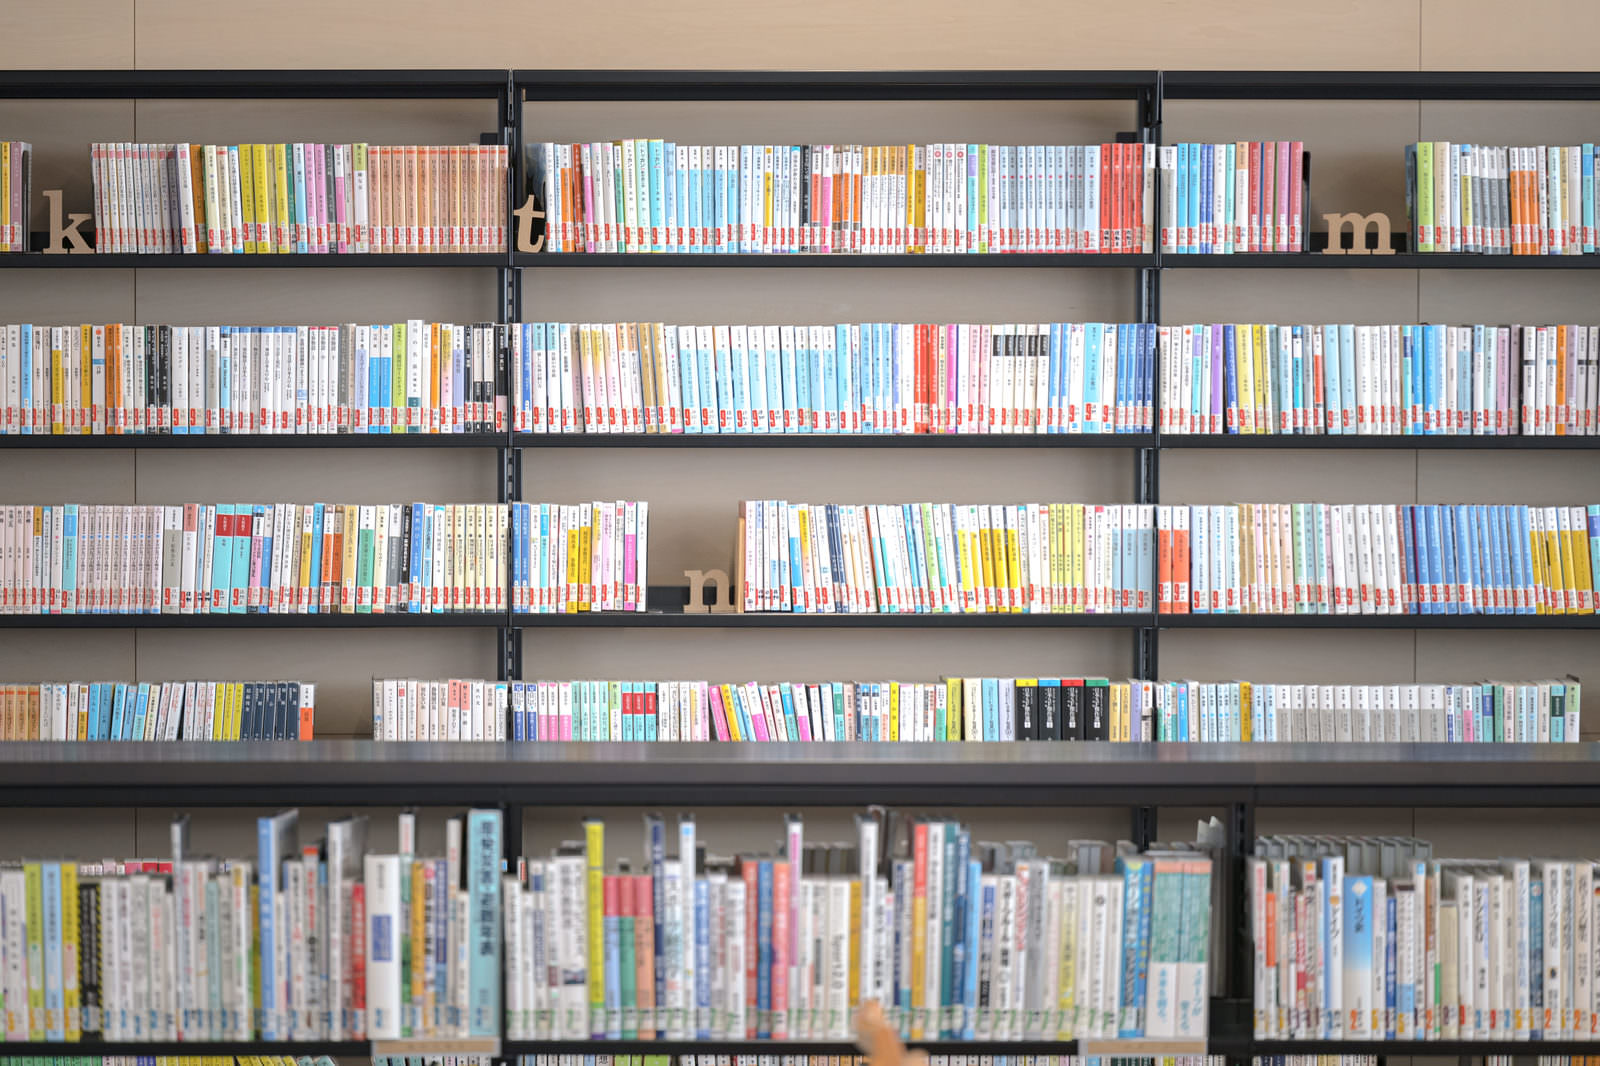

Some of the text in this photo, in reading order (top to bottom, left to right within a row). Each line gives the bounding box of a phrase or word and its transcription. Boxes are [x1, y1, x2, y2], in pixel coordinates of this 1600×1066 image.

[42, 189, 95, 254] k
[513, 194, 545, 253] t
[1322, 212, 1396, 255] m
[683, 569, 735, 613] n
[1544, 1008, 1552, 1030] 2
[1574, 1008, 1582, 1030] 2
